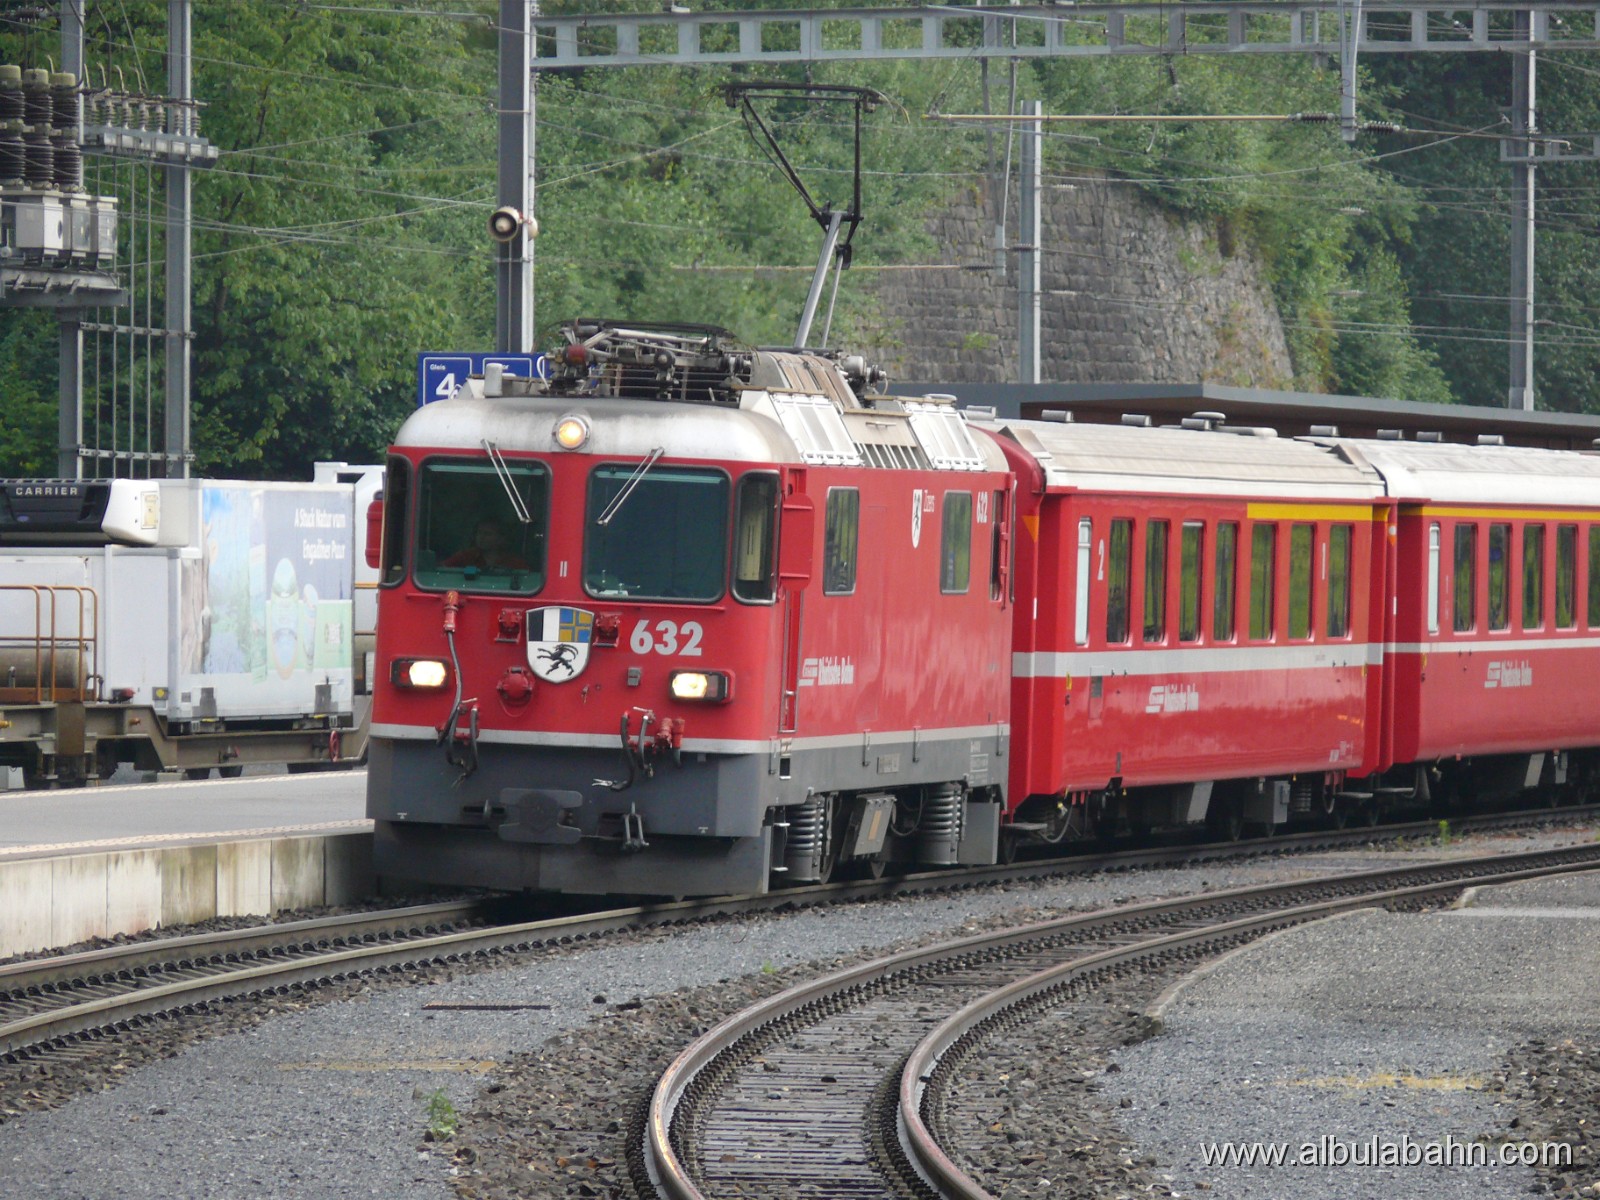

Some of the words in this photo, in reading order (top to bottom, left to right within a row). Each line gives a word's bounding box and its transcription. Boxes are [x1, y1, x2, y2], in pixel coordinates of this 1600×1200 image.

[429, 363, 446, 371] Gleis
[435, 373, 455, 399] 4
[15, 487, 78, 496] CARRIER
[976, 491, 988, 524] 632
[1097, 538, 1105, 581] 2
[629, 619, 704, 656] 632
